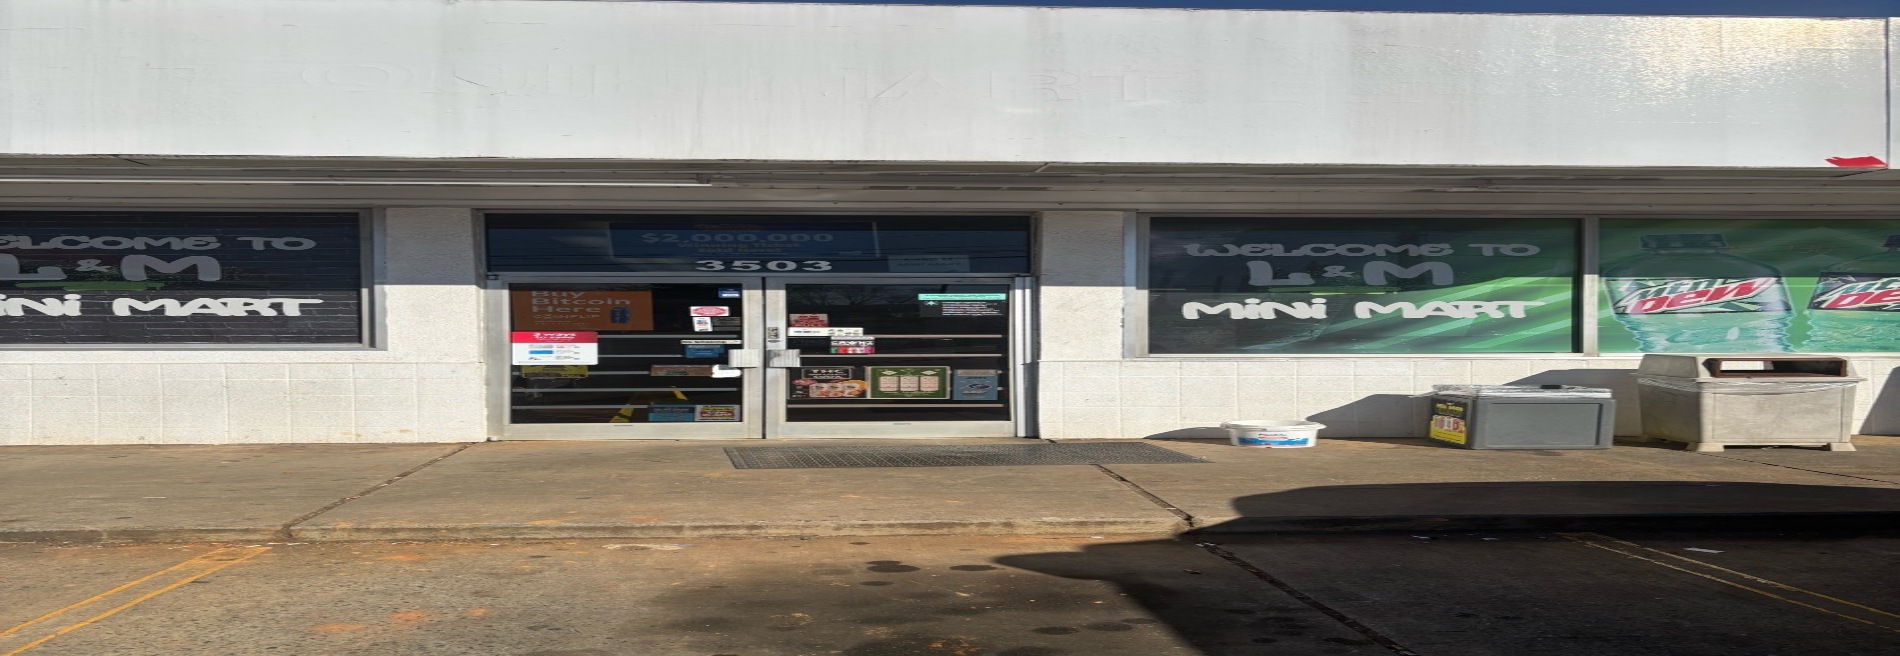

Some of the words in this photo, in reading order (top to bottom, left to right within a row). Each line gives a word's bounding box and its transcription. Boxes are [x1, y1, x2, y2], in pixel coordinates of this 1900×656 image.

[0, 235, 222, 250] ELCOME
[237, 236, 318, 250] TO
[641, 232, 834, 243] $2,000,000
[1182, 243, 1454, 257] WELCOME
[1468, 243, 1541, 257] TO
[0, 253, 67, 280] L
[76, 259, 111, 272] &
[121, 254, 222, 281] M
[695, 260, 832, 271] 3503
[1246, 260, 1315, 287] L
[1323, 265, 1354, 278] &
[1363, 260, 1454, 287] M
[532, 290, 586, 298] Buy
[532, 297, 631, 305] Bitcoin
[112, 297, 324, 317] MART
[532, 305, 602, 313] Here
[1354, 301, 1546, 319] MART
